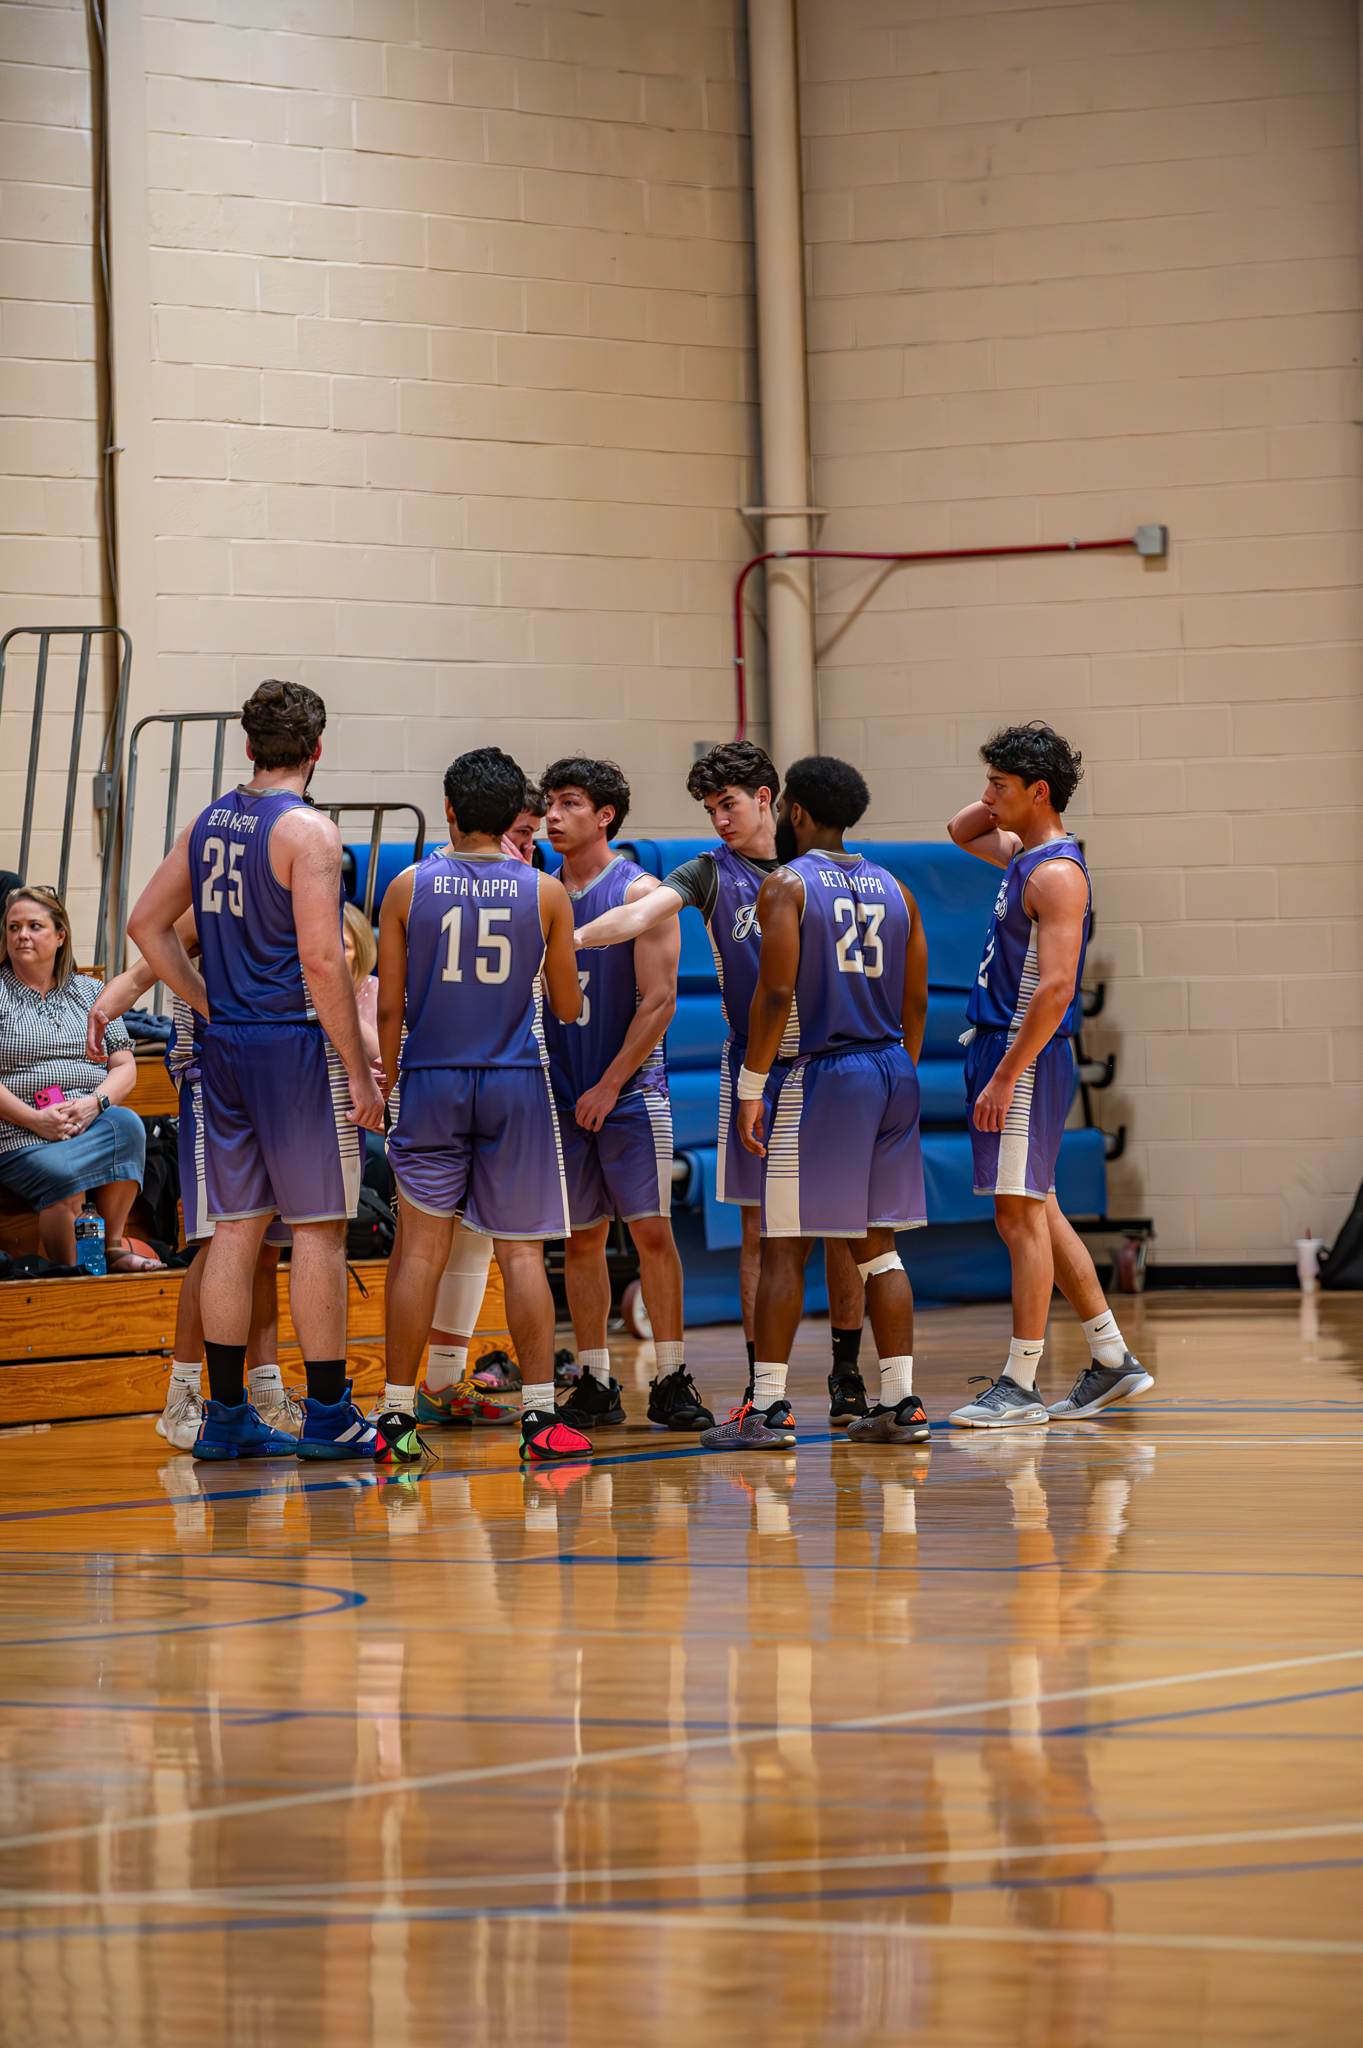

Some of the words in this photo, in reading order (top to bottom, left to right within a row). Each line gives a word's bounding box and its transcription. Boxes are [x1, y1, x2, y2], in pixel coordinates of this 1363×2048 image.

[207, 808, 231, 828] BETA
[201, 836, 246, 918] 25
[433, 875, 468, 897] BETA
[472, 878, 518, 898] KAPPA
[818, 870, 850, 890] BETA
[440, 905, 512, 985] 15
[833, 896, 886, 979] 23
